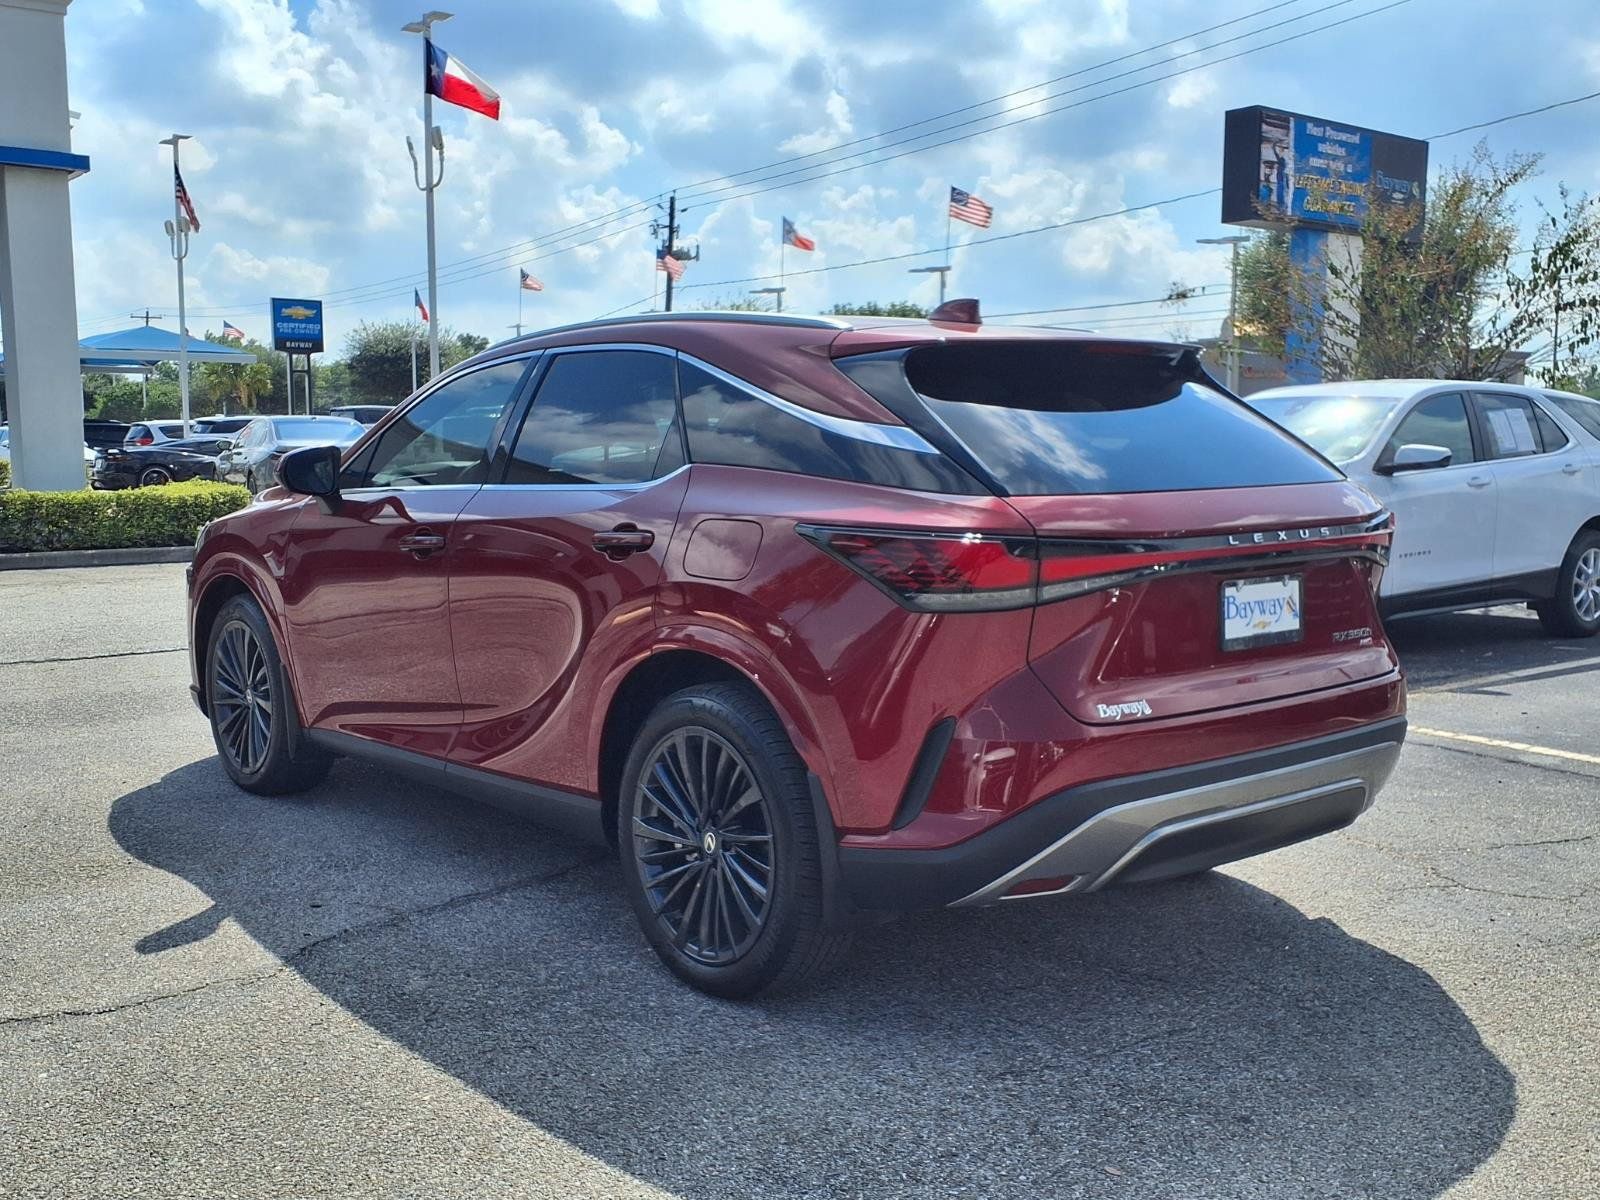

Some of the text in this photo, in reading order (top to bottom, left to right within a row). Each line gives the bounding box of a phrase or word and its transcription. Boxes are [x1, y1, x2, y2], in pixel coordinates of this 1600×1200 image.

[1228, 527, 1330, 545] LEXUS
[1225, 595, 1286, 627] Bayway
[1096, 701, 1143, 720] Bayway
